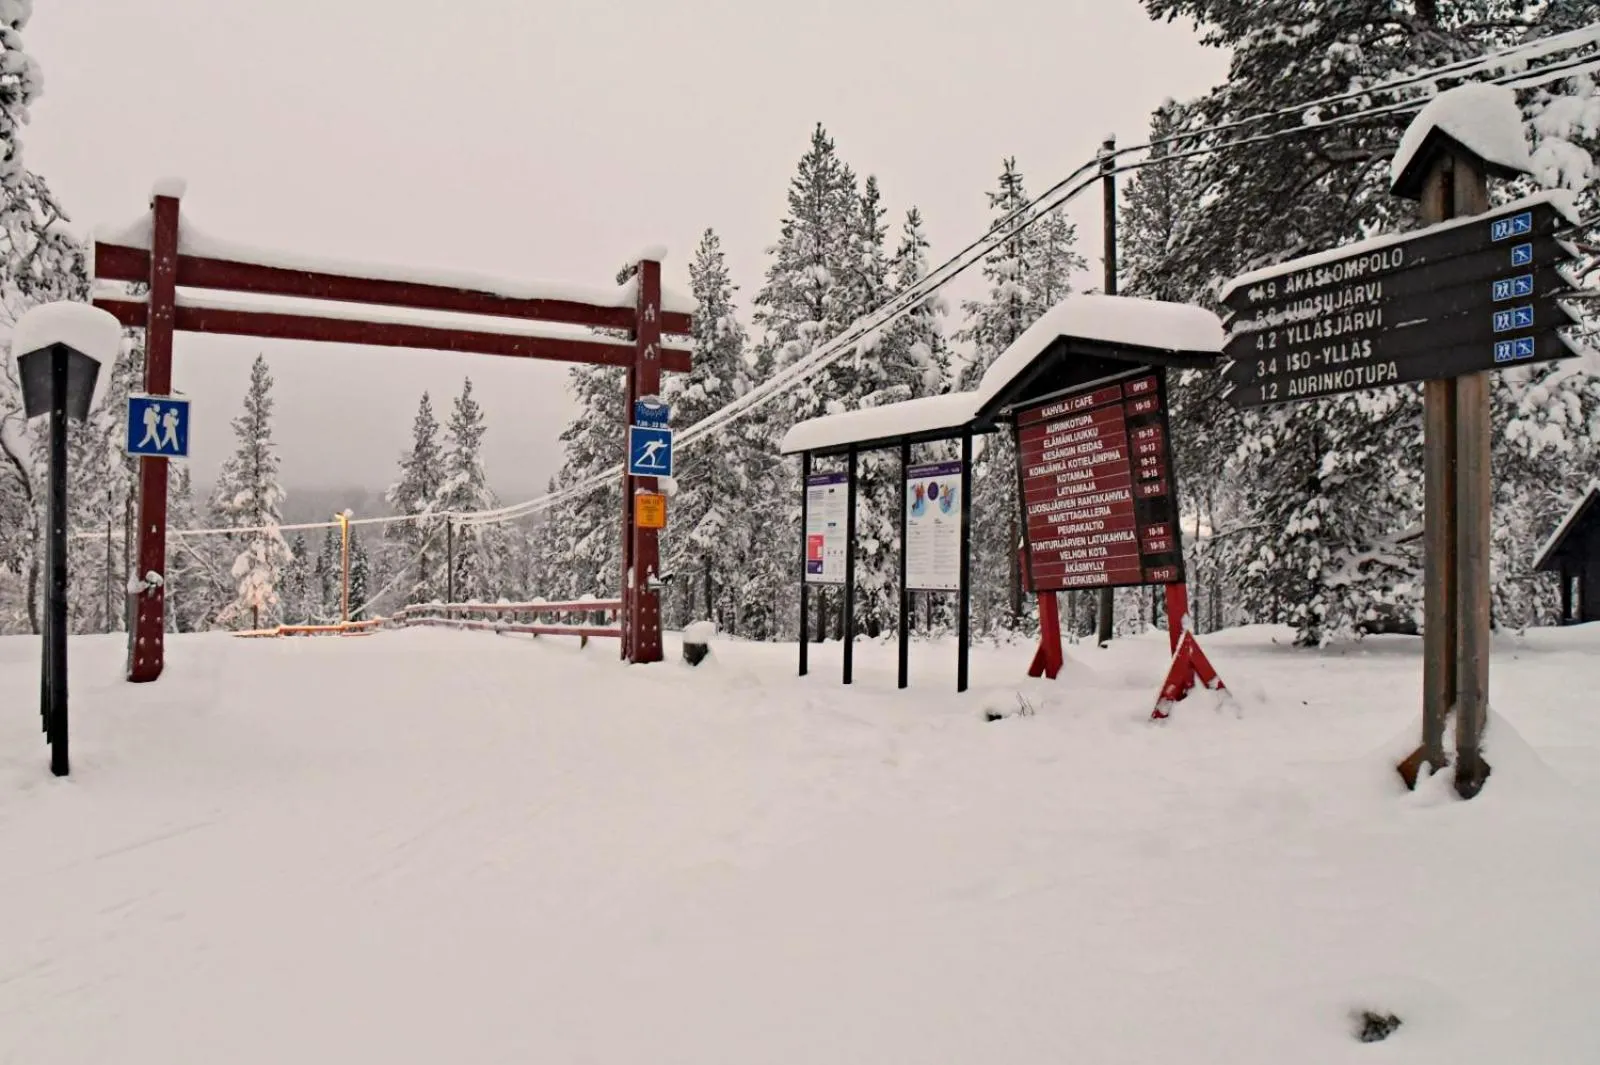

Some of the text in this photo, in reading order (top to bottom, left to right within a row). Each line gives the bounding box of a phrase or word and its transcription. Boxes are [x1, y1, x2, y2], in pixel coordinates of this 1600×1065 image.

[1256, 332, 1277, 350] 4.2
[1256, 358, 1277, 377] 3.4
[1133, 381, 1148, 392] OPEN
[1260, 361, 1398, 400] 1.2 AURINKOTUPA
[1042, 402, 1070, 417] KAHVILA
[1046, 415, 1093, 434] AURINKOTUPA
[1043, 427, 1099, 448] ELÄMÄNLUUKKU
[1042, 440, 1103, 461] KESÄNGIN KEIDAS
[1056, 468, 1094, 483] KOTAMAJA
[1056, 481, 1097, 496] LATVAMAJA
[1028, 490, 1130, 514] LUOSUJÄRVEN RANTAKAHVILA
[1047, 506, 1111, 523] NAVETTAGALLERIA
[1057, 520, 1105, 535] PEURAKALTIO
[1087, 530, 1135, 545] LATUKAHVILA
[1059, 546, 1108, 560] VELHON KOTA
[1064, 561, 1105, 573] ÄKÄSMYLLY
[1062, 574, 1108, 586] KUERKIEVARI
